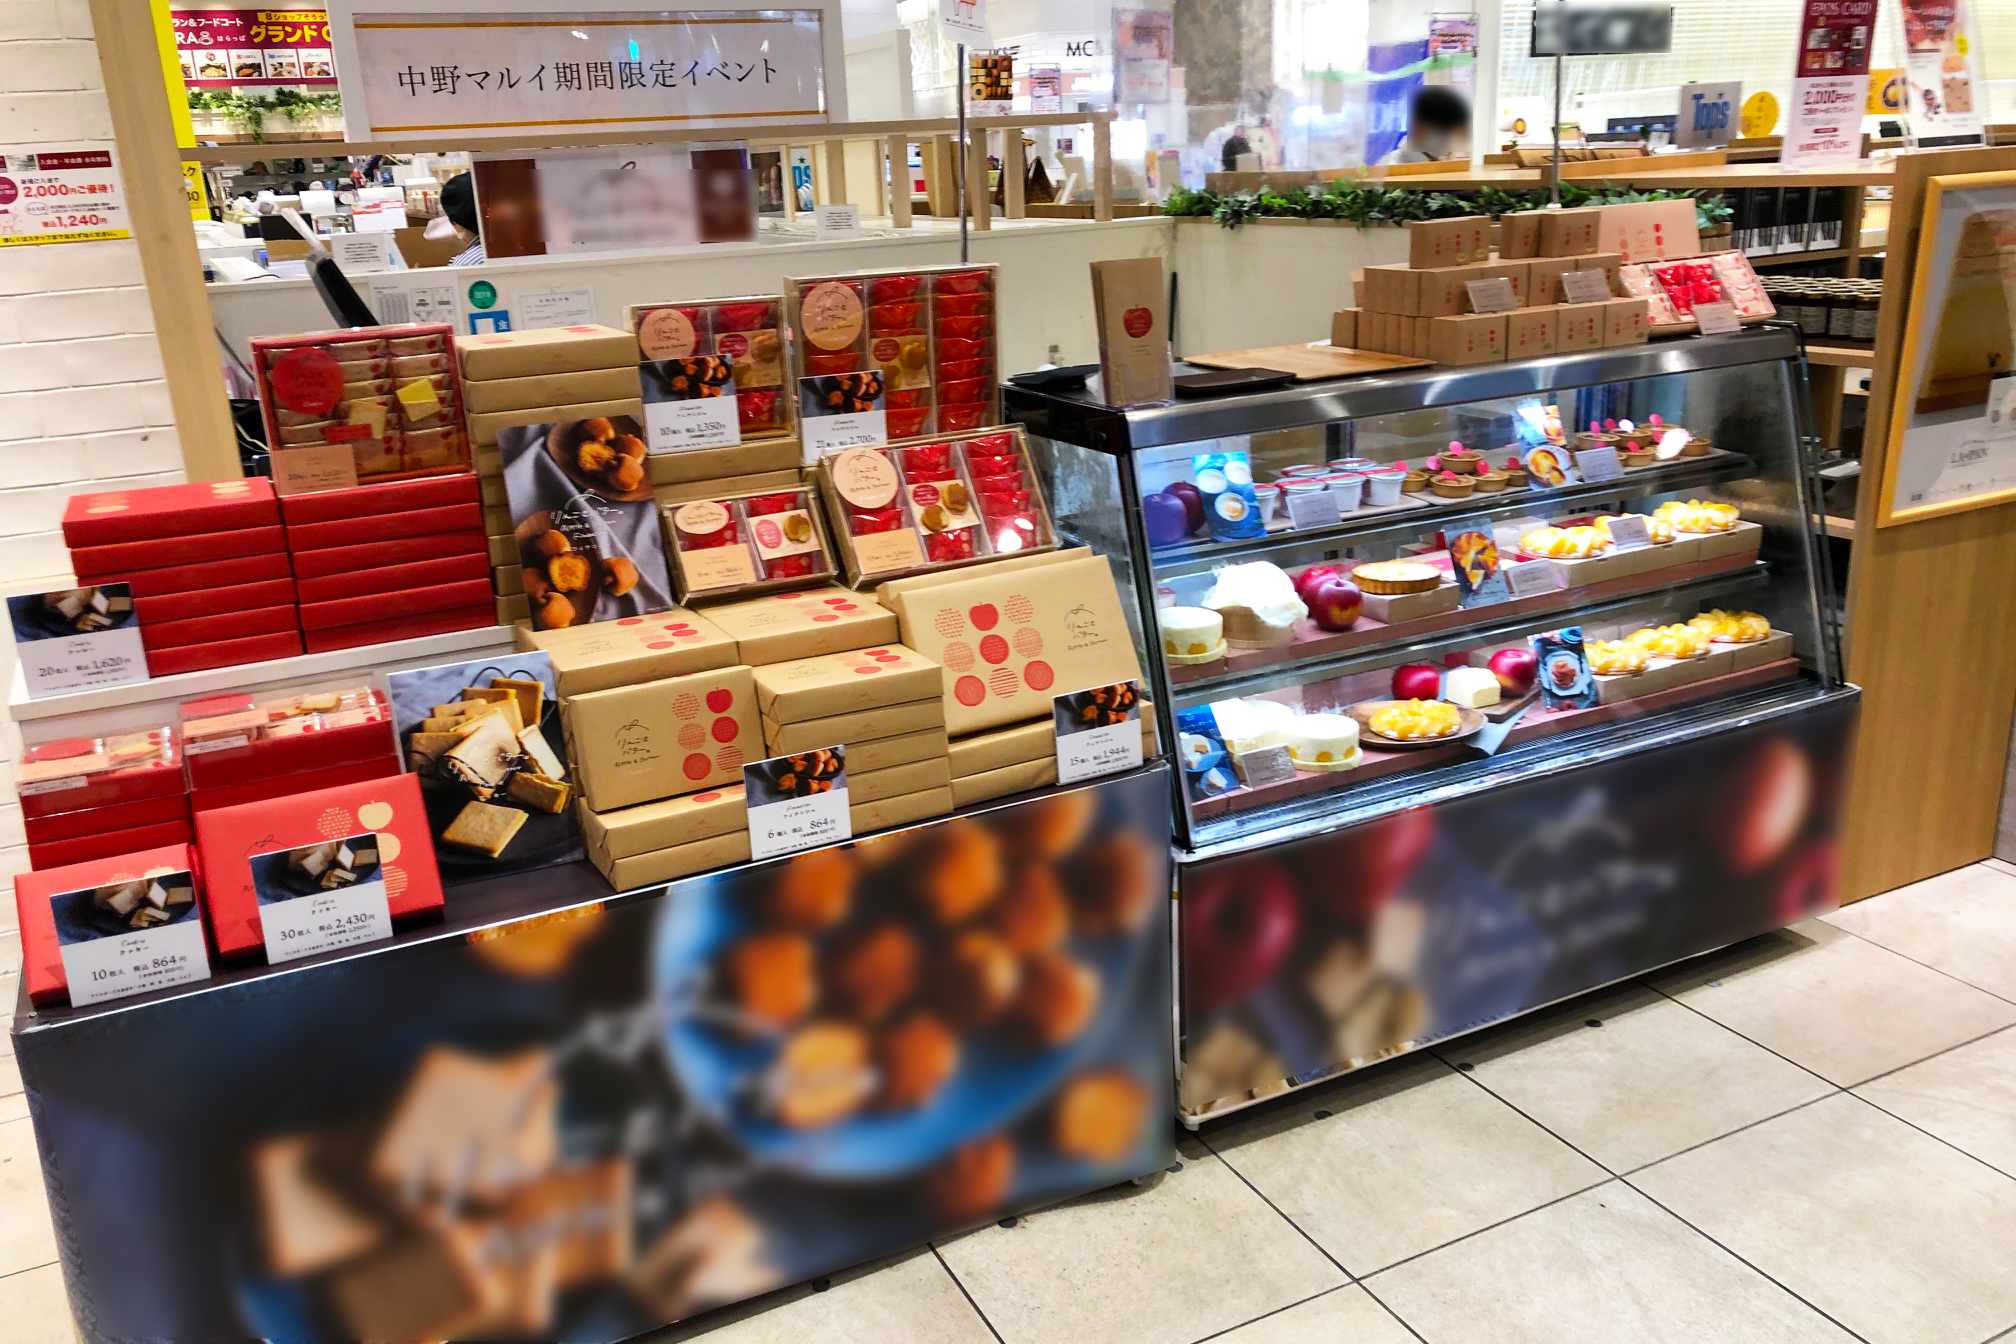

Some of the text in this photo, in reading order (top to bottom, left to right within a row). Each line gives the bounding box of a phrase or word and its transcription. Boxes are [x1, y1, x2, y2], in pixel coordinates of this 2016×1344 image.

[265, 11, 328, 21] 8ショップそろっ
[398, 58, 777, 97] 中野マルイ期間限定イベント
[335, 913, 375, 929] 2,430円
